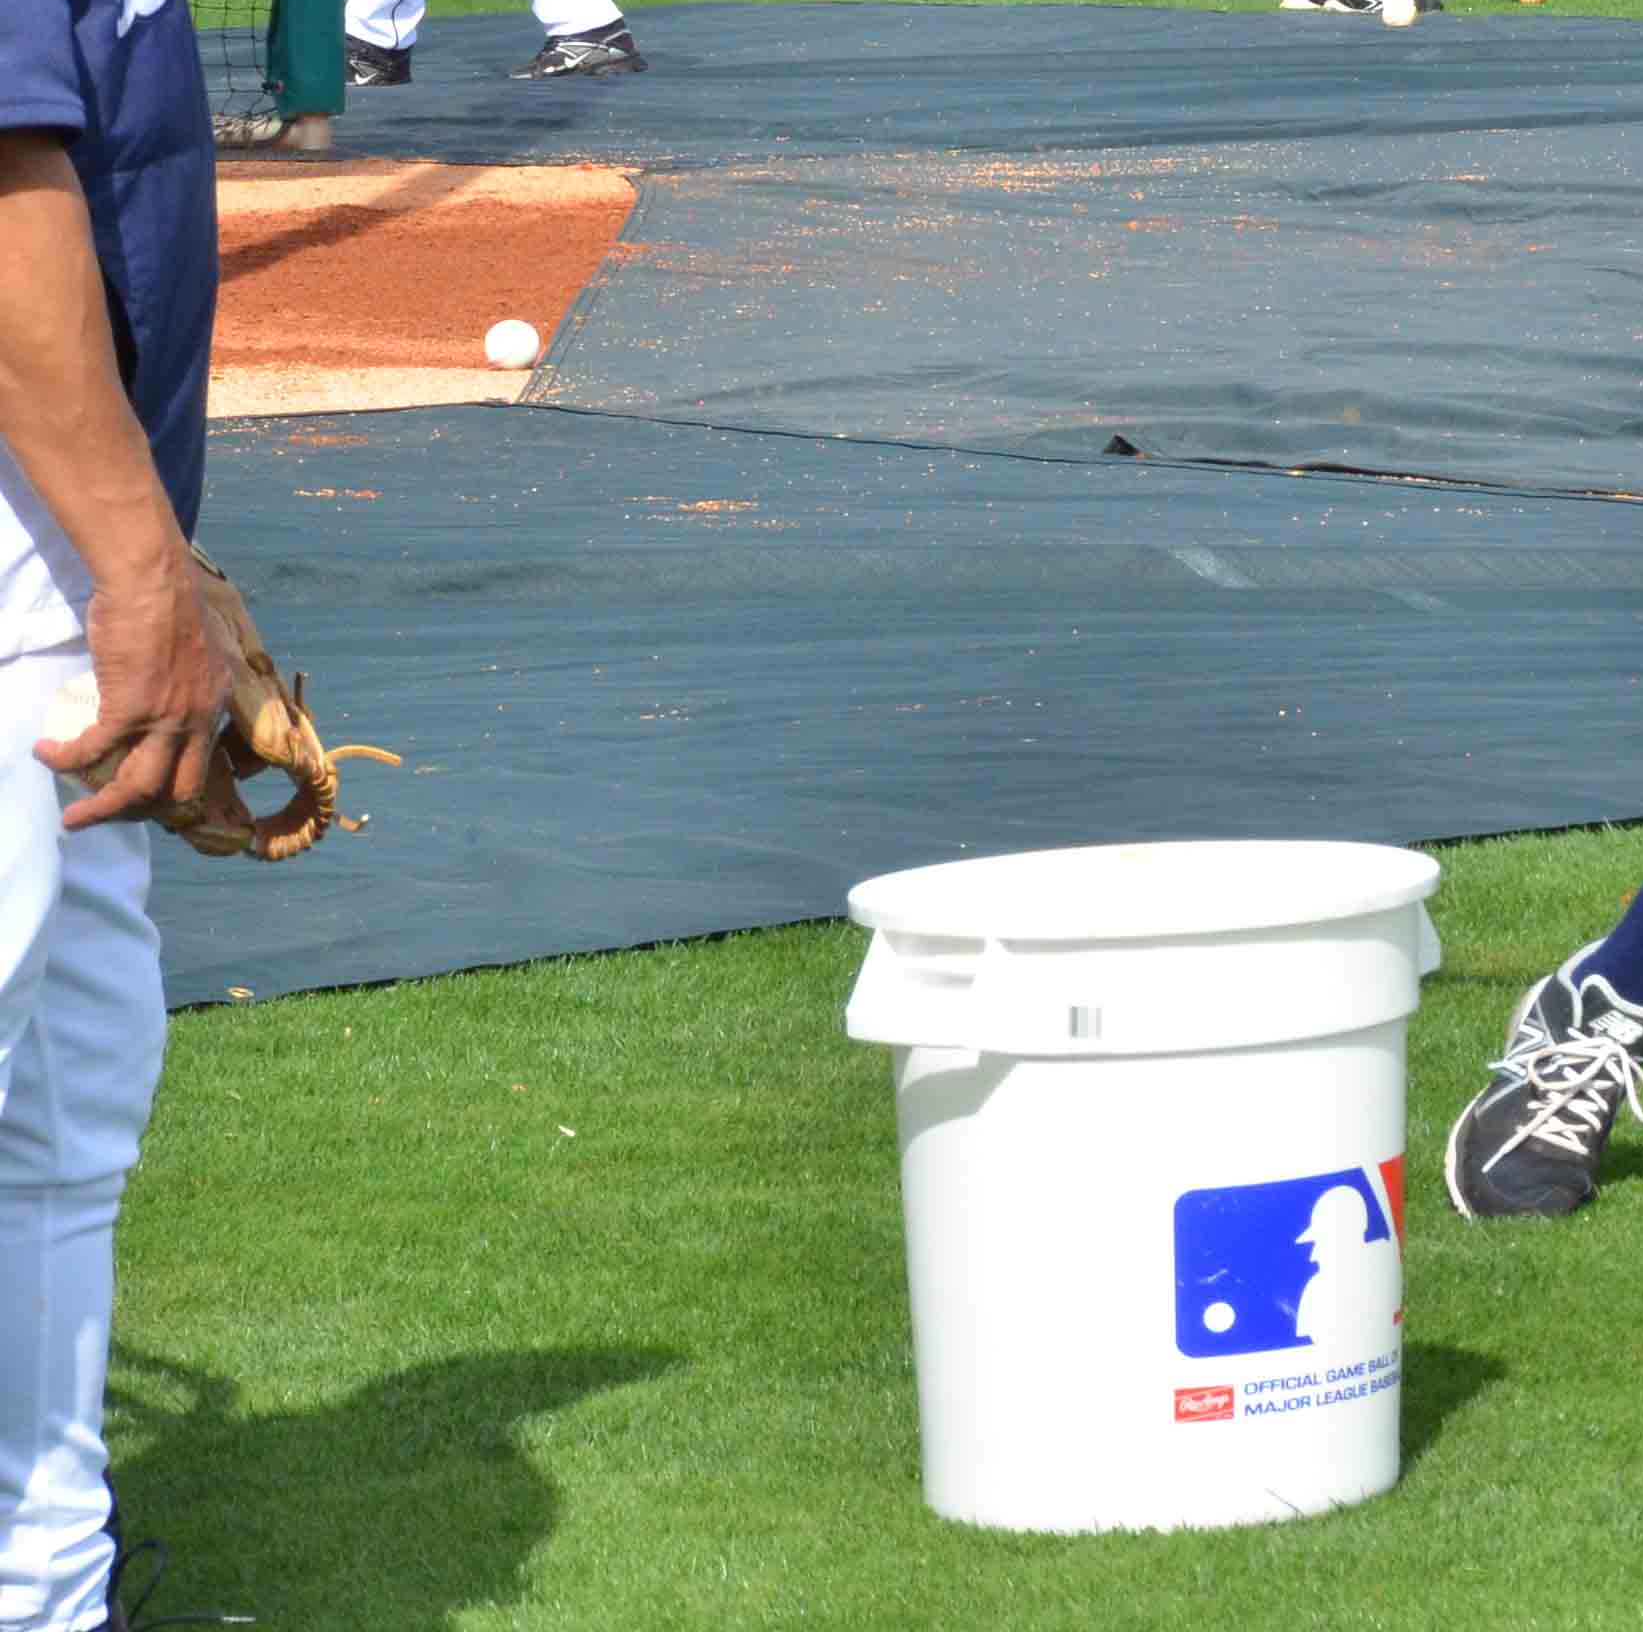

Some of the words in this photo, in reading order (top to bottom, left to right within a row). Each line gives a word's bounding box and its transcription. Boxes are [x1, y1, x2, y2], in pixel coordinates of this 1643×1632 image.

[1244, 1373, 1321, 1396] OFFICIAL
[1326, 1361, 1367, 1383] GAME
[1243, 1395, 1312, 1417] MAJOR
[1315, 1383, 1368, 1407] LEAGUE
